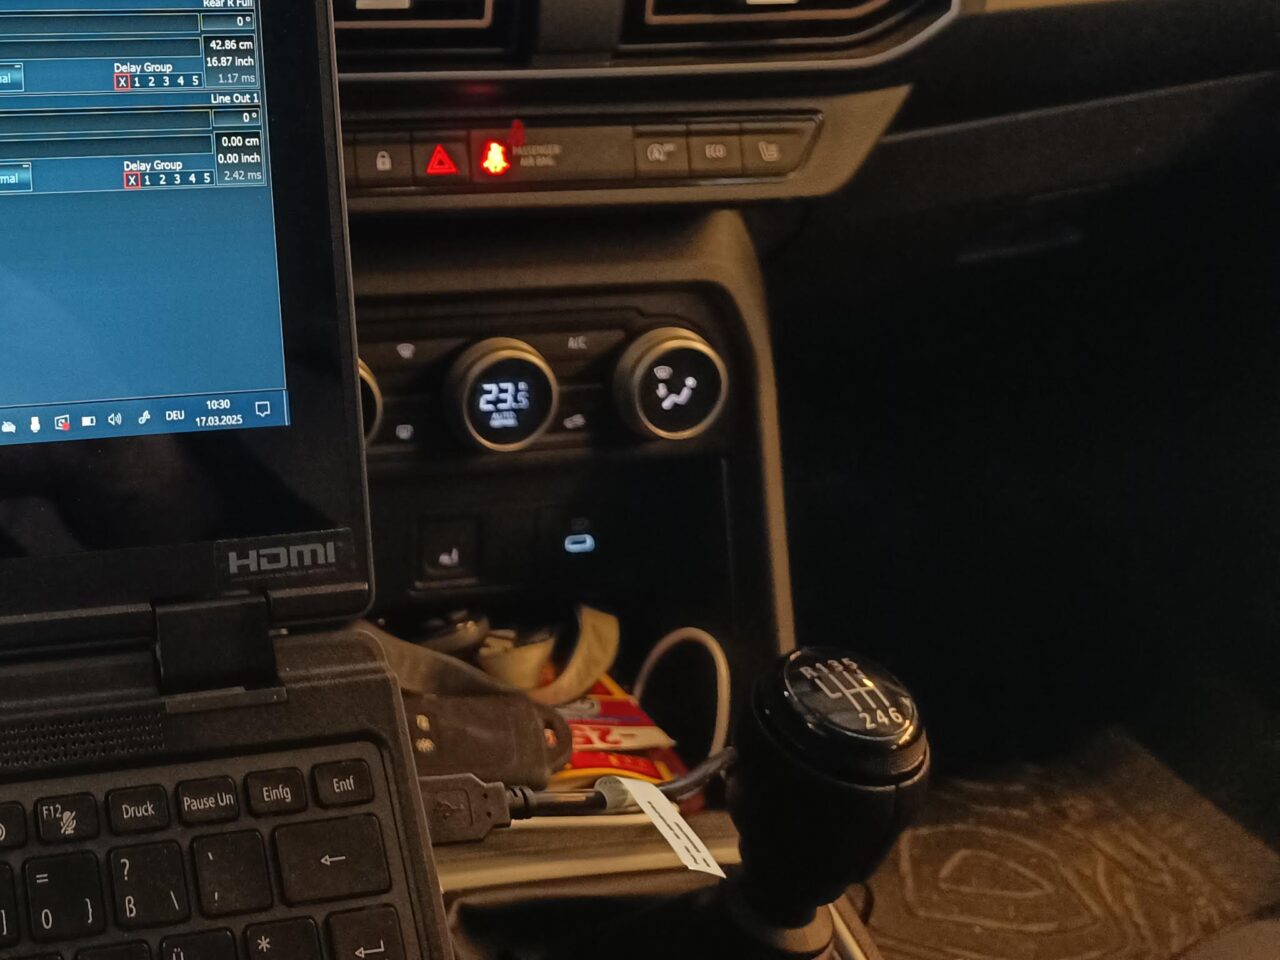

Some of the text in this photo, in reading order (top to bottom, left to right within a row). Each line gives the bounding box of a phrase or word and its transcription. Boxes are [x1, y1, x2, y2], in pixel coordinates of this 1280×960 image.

[210, 40, 236, 50] 42.86
[206, 56, 254, 67] 16.87 inch
[219, 74, 238, 83] 1.17
[211, 94, 258, 103] Line Out 1
[222, 137, 259, 146] 0.00 cm
[218, 153, 261, 163] 0.00 inch
[224, 171, 261, 180] 2.42 ms
[206, 399, 230, 410] 10:30
[165, 410, 185, 422] DEU
[195, 414, 243, 428] 17.03.2025
[228, 541, 336, 574] HDMI
[333, 775, 355, 792] Entf
[262, 785, 292, 802] Einfg
[183, 792, 234, 811] Pause Un
[42, 804, 62, 820] F12
[122, 802, 155, 819] Druck
